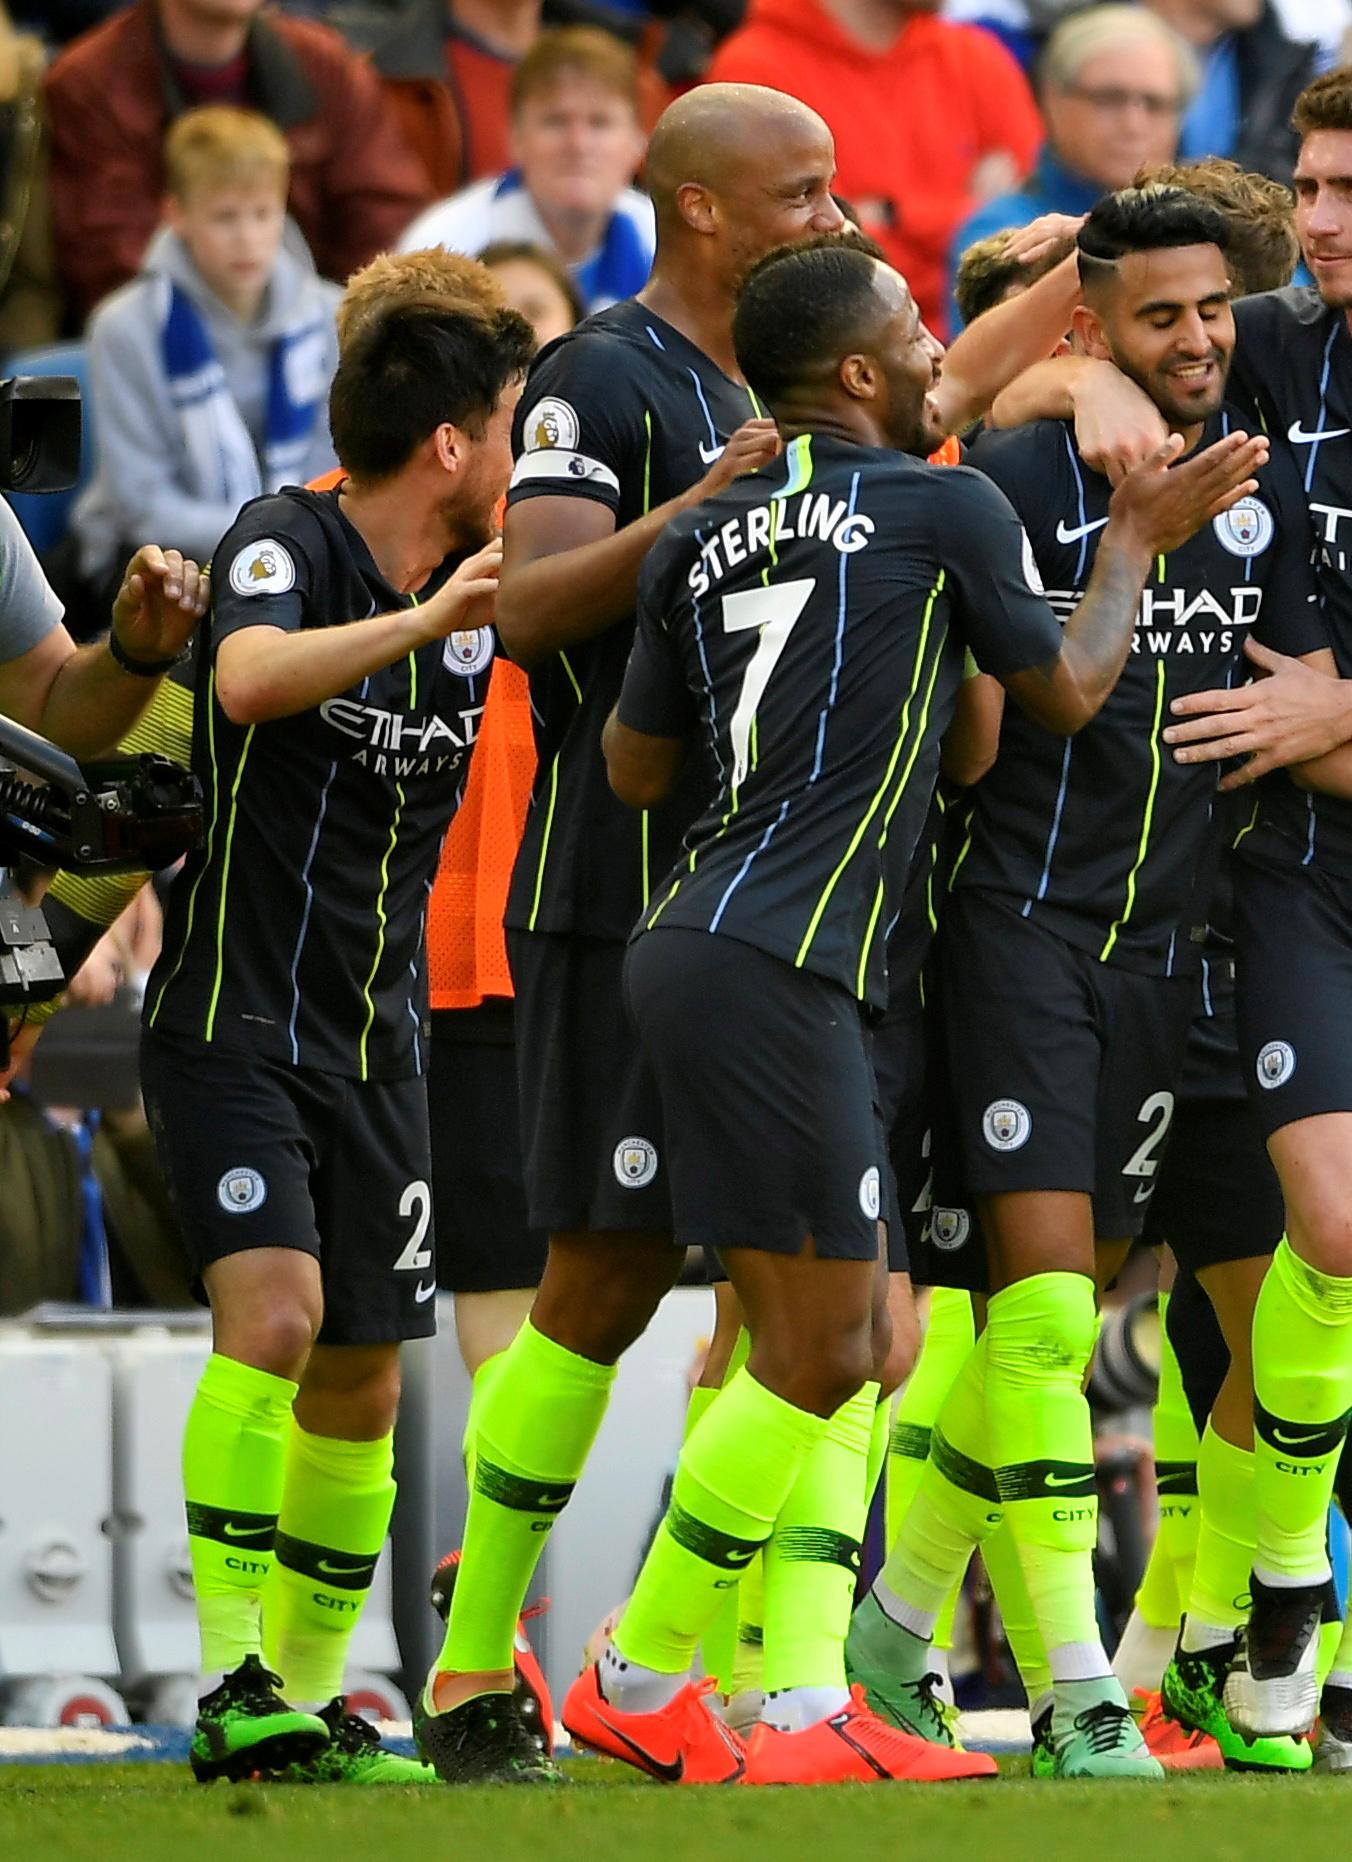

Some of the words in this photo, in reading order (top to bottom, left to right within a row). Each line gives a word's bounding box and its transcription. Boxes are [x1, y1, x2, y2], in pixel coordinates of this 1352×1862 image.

[688, 493, 876, 599] STERLING
[1130, 632, 1234, 654] RWAYS
[722, 578, 816, 789] 7
[352, 750, 463, 777] ARWAYS
[1121, 1091, 1174, 1176] 2
[393, 1180, 432, 1270] 2
[1275, 1461, 1326, 1476] CITY
[1052, 1508, 1095, 1522] CITY
[225, 1557, 270, 1574] CITY
[313, 1593, 359, 1612] CITY
